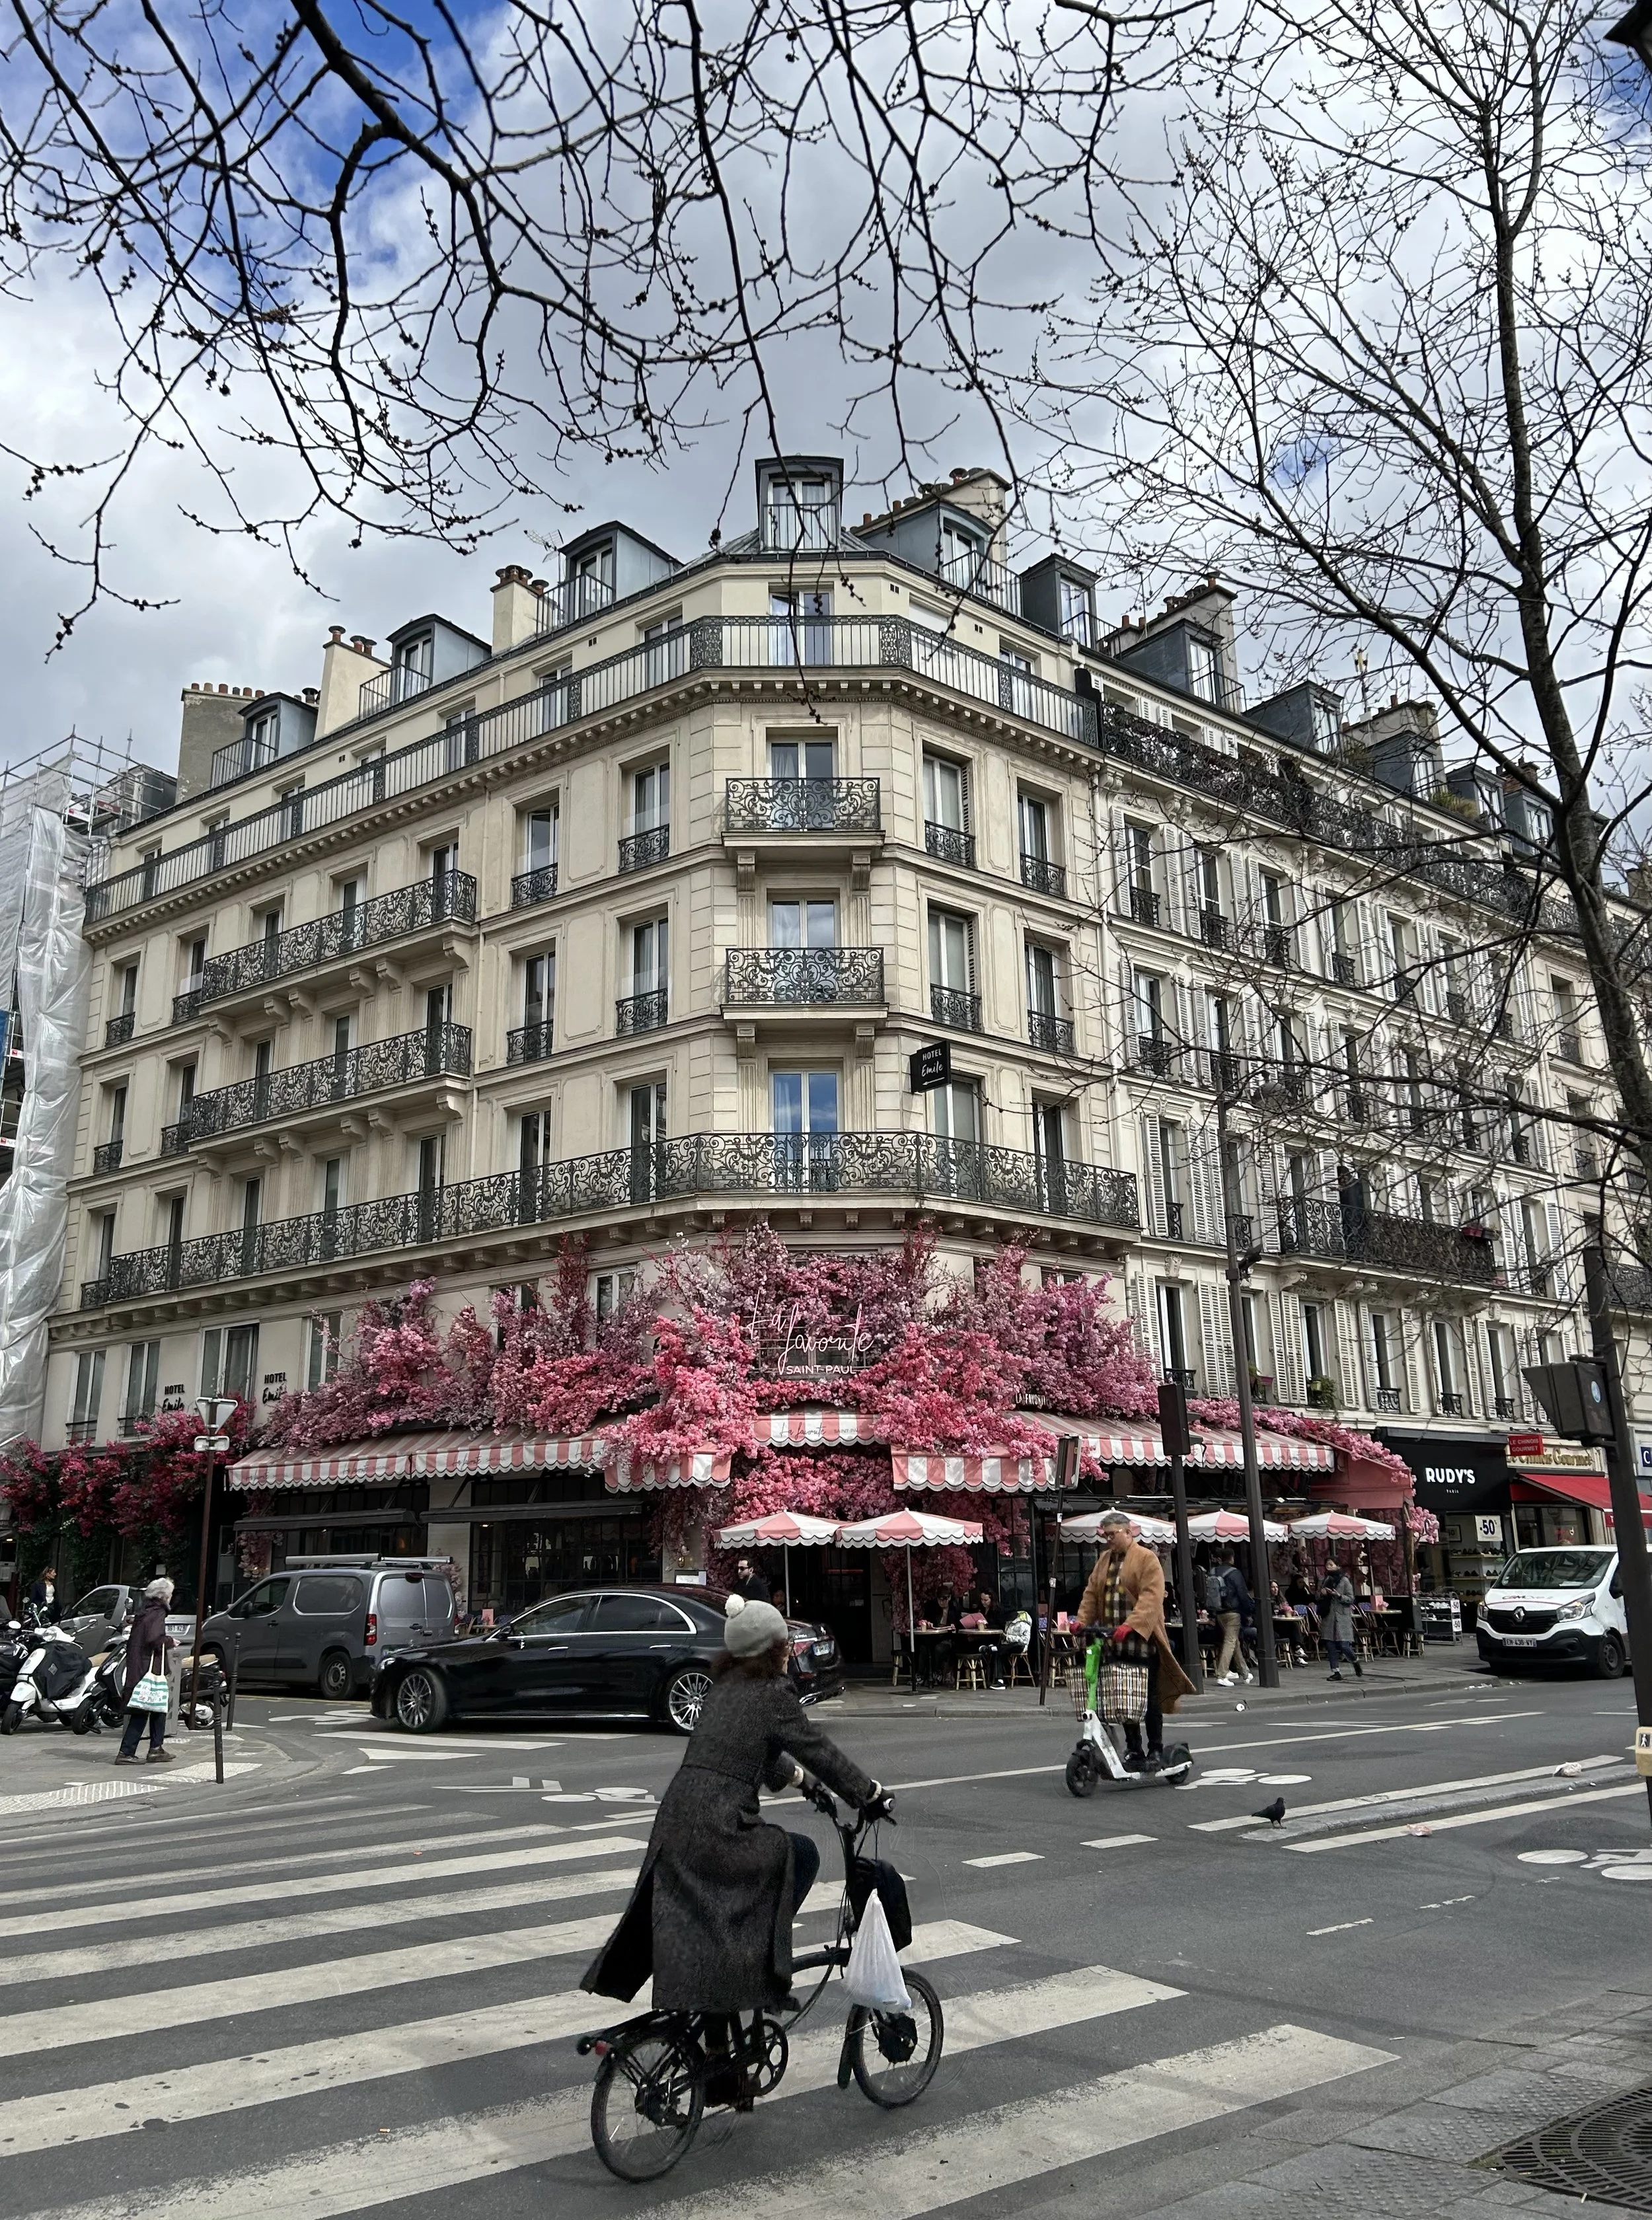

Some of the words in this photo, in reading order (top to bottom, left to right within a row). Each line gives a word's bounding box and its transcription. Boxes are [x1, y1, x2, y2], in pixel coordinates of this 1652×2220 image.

[922, 1049, 942, 1061] HOTEL
[922, 1060, 943, 1077] Emile
[747, 1288, 786, 1340] La
[786, 1364, 857, 1374] SAINT-PAUL
[264, 1372, 287, 1384] HOTEL
[165, 1384, 185, 1395] HOTEL
[1425, 1467, 1476, 1484] RUDY'S
